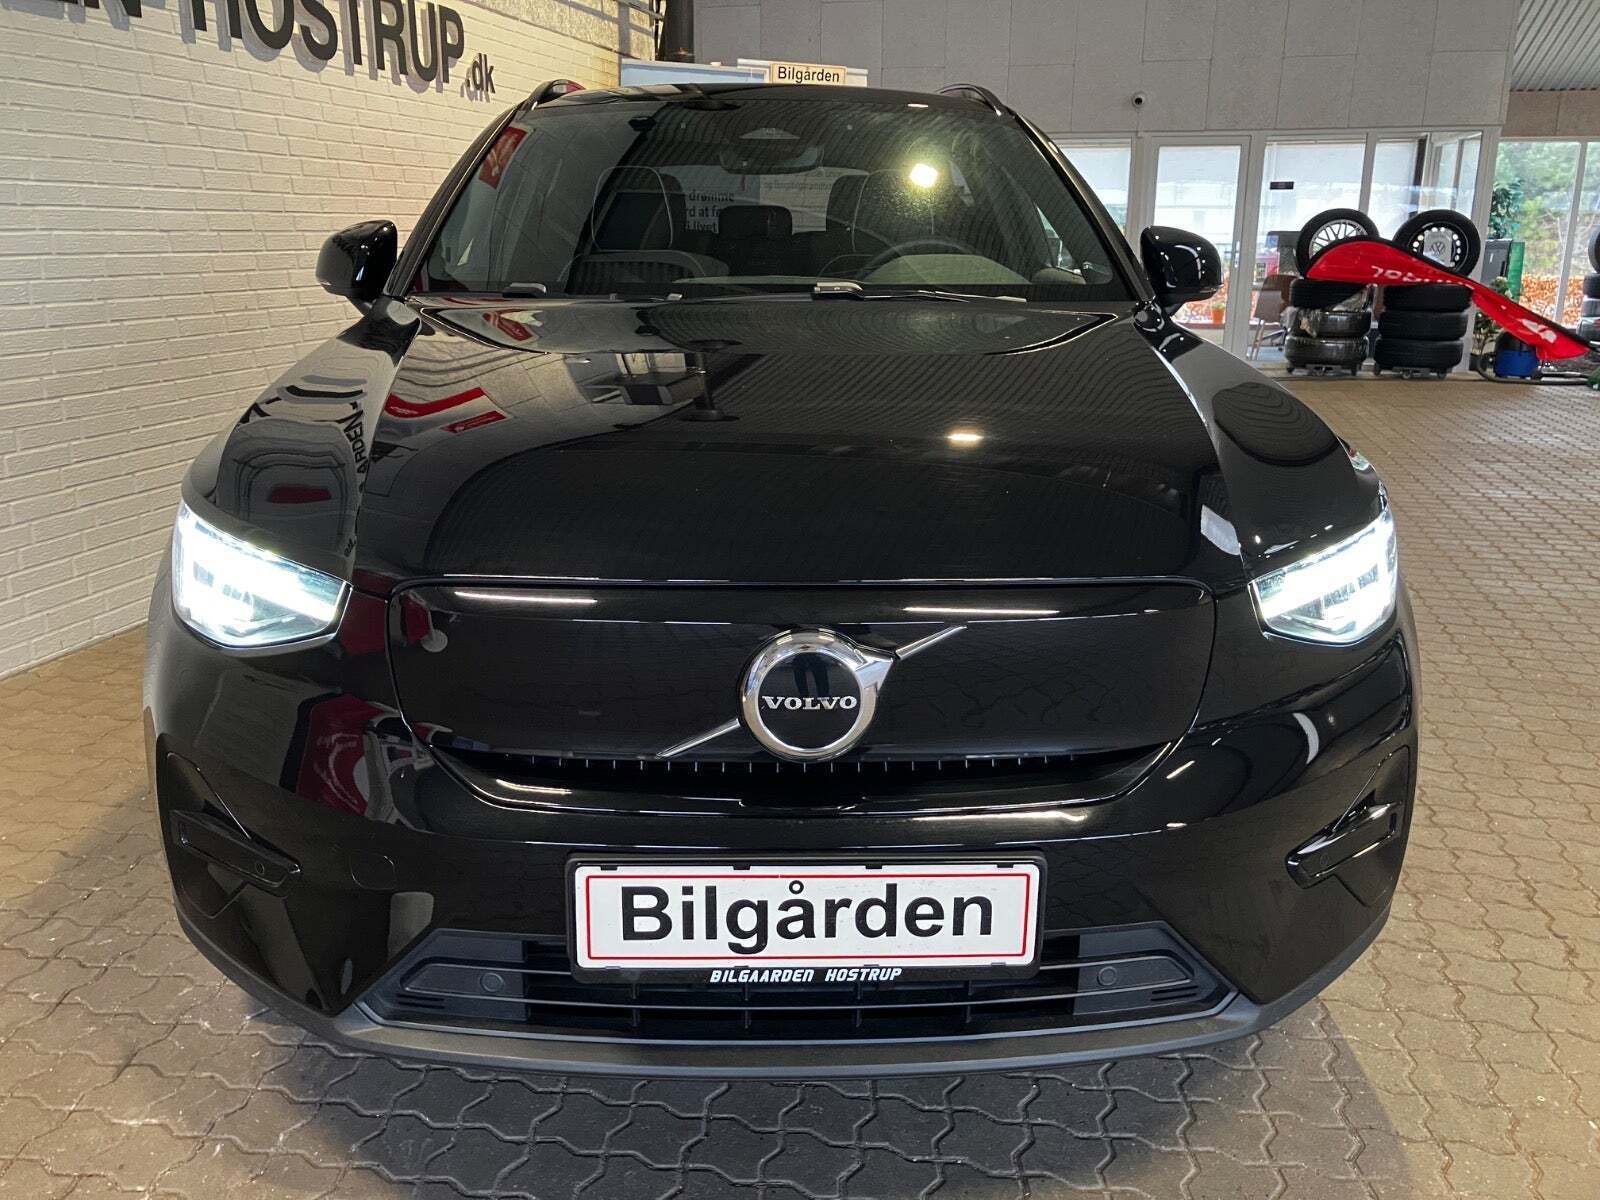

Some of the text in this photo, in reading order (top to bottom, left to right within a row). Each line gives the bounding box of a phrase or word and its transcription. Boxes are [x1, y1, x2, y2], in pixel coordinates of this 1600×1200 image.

[778, 66, 840, 83] Bilgården
[762, 695, 857, 710] VOLVO
[620, 879, 993, 955] Bilgården
[710, 967, 903, 983] BILGAARDEN HOSTRUP
